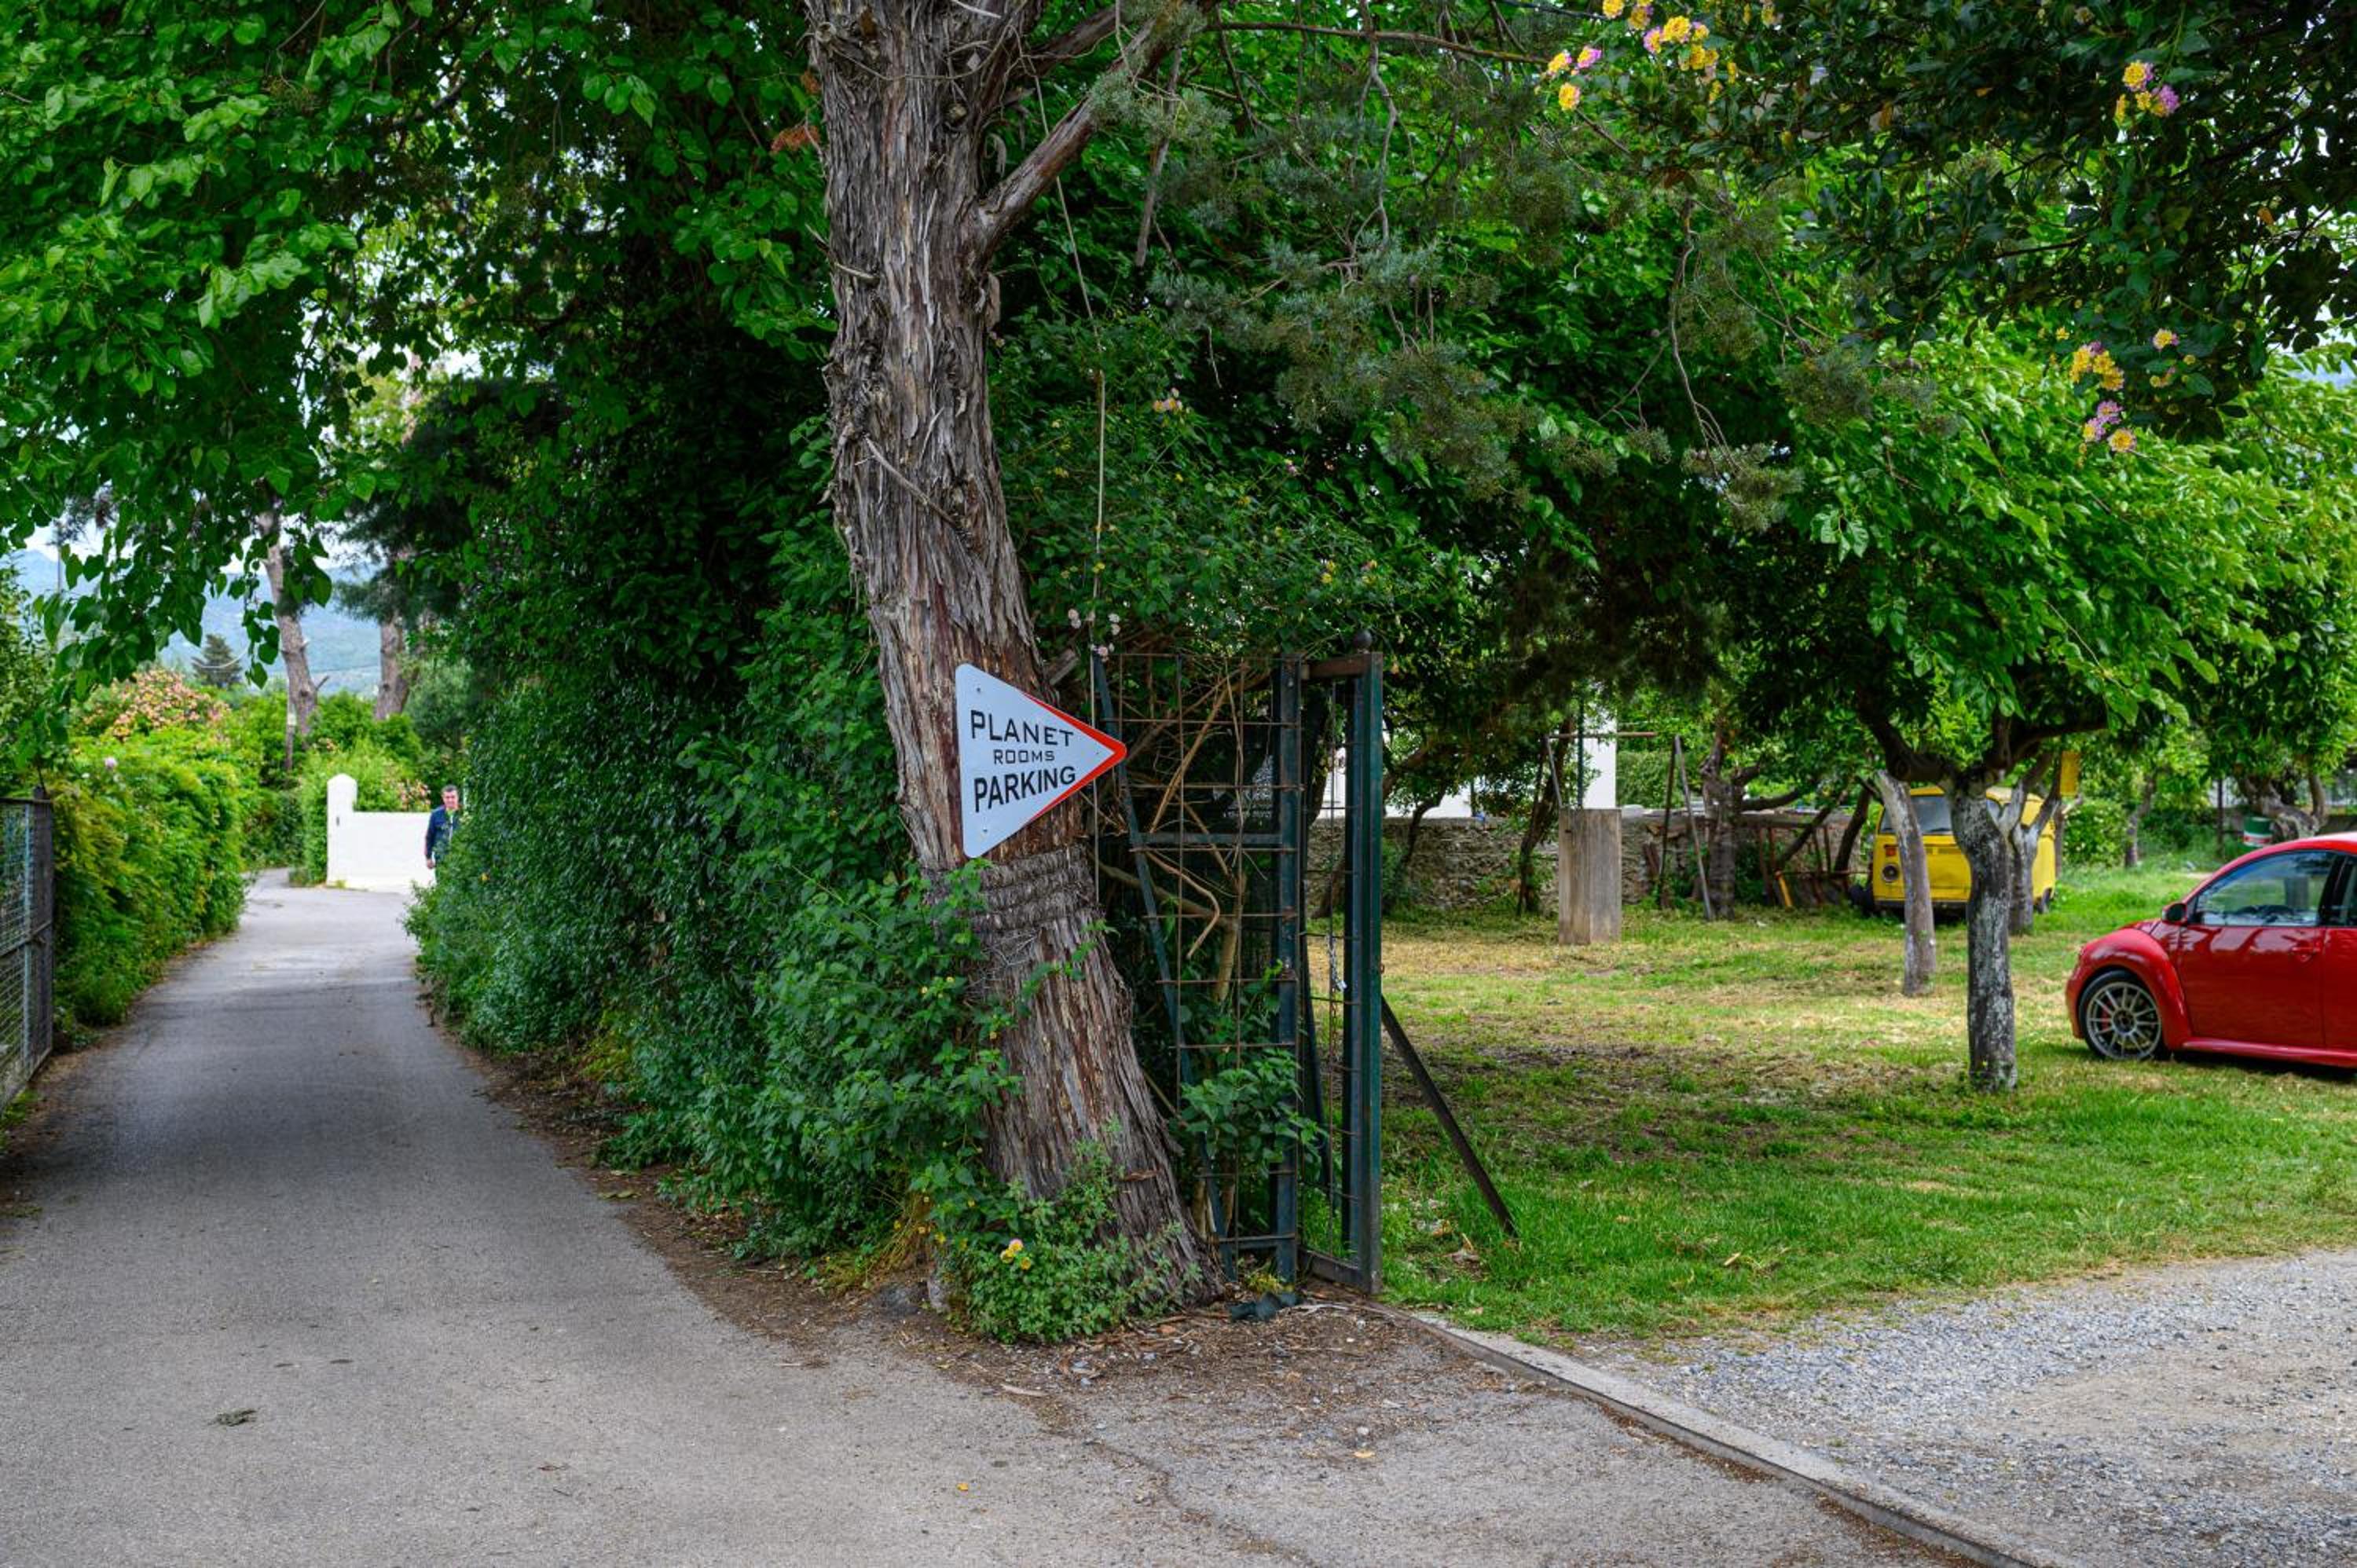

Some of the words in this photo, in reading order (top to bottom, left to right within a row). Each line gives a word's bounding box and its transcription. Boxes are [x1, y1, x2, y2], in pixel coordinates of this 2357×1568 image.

[970, 709, 1074, 747] PLANET
[993, 749, 1055, 765] ROOMS
[973, 765, 1076, 813] PARKING
